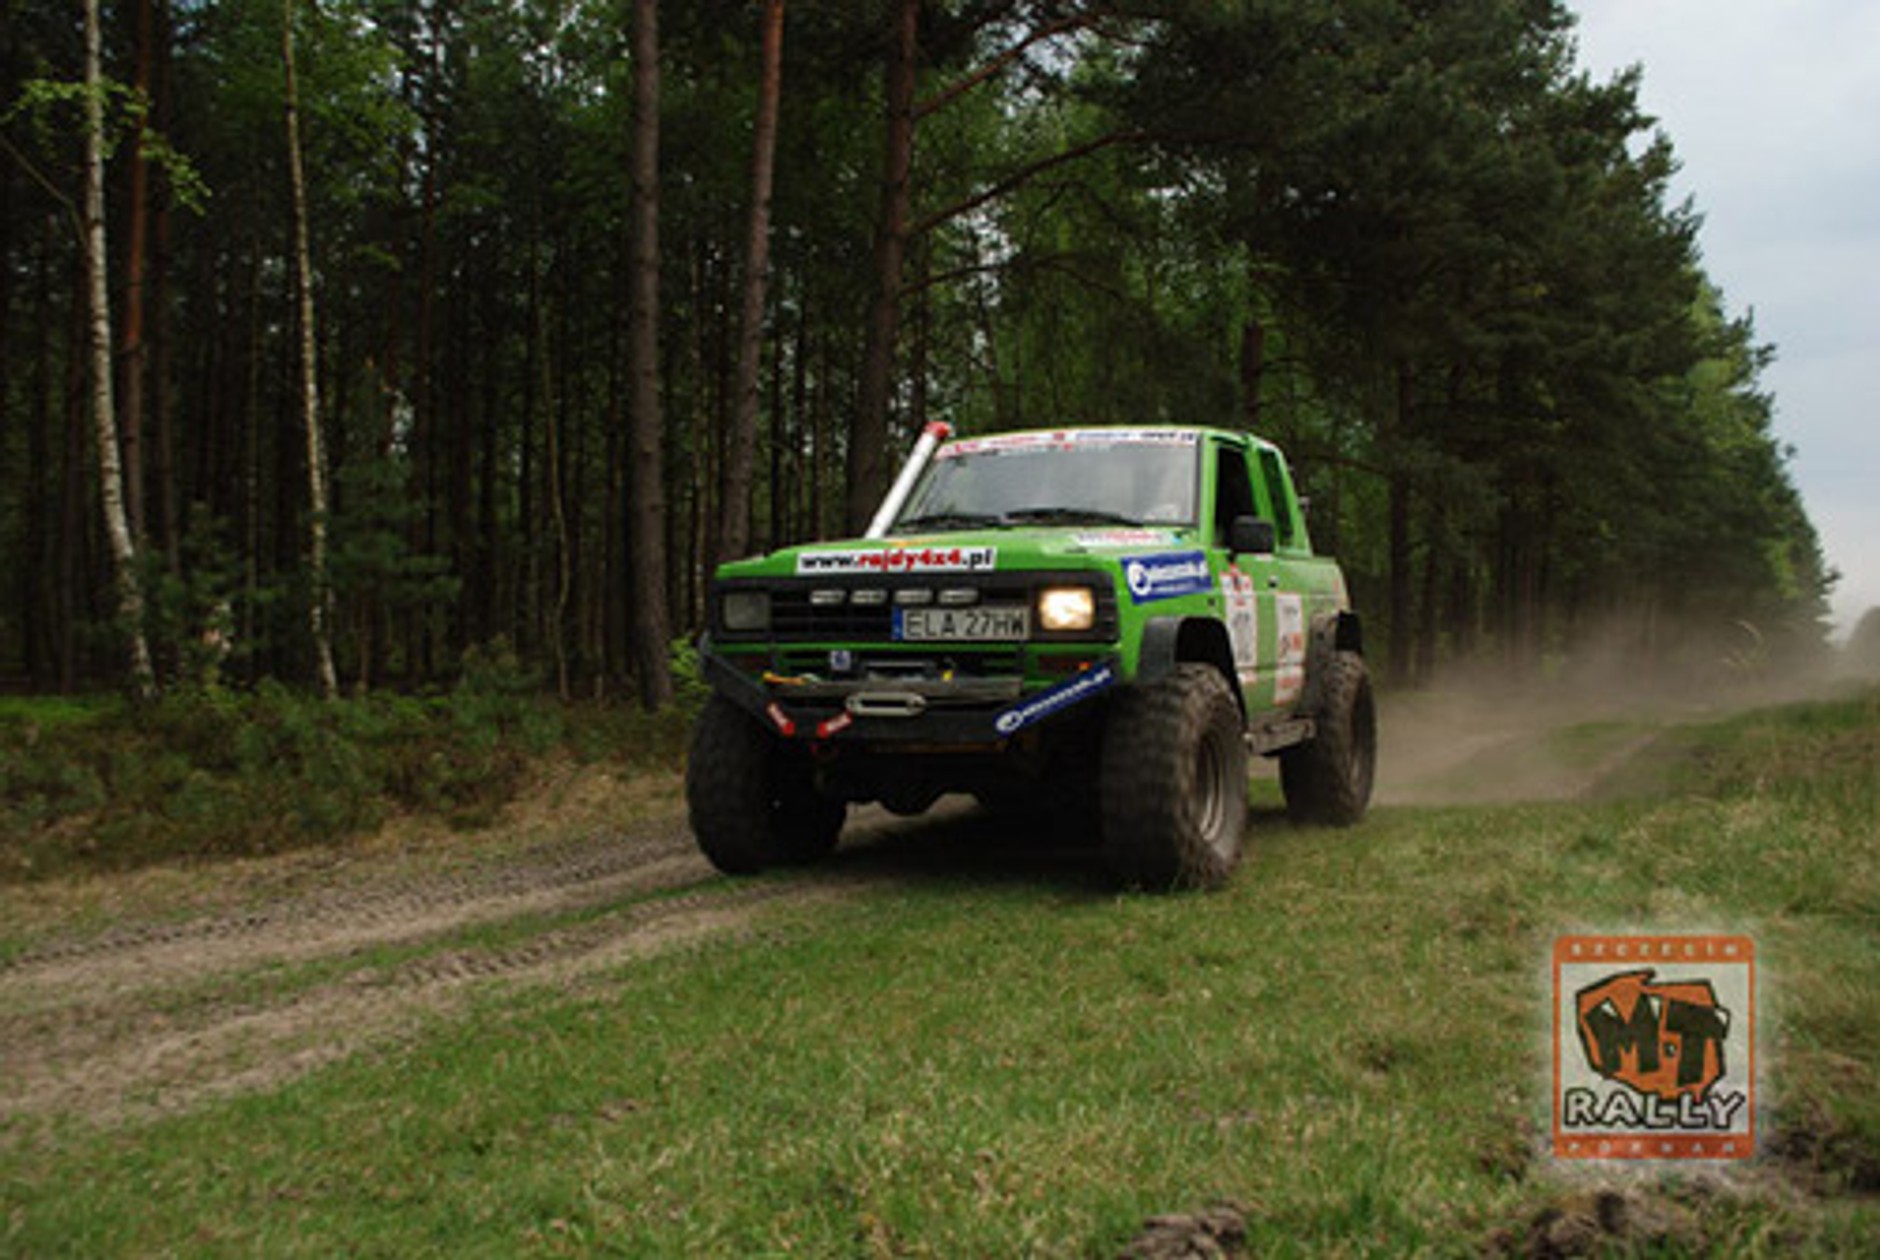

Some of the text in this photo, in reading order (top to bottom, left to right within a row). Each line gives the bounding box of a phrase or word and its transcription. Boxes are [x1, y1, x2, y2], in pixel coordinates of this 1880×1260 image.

[801, 548, 993, 570] www.rajdy4x4.pl
[904, 609, 1025, 637] ELA 27HW
